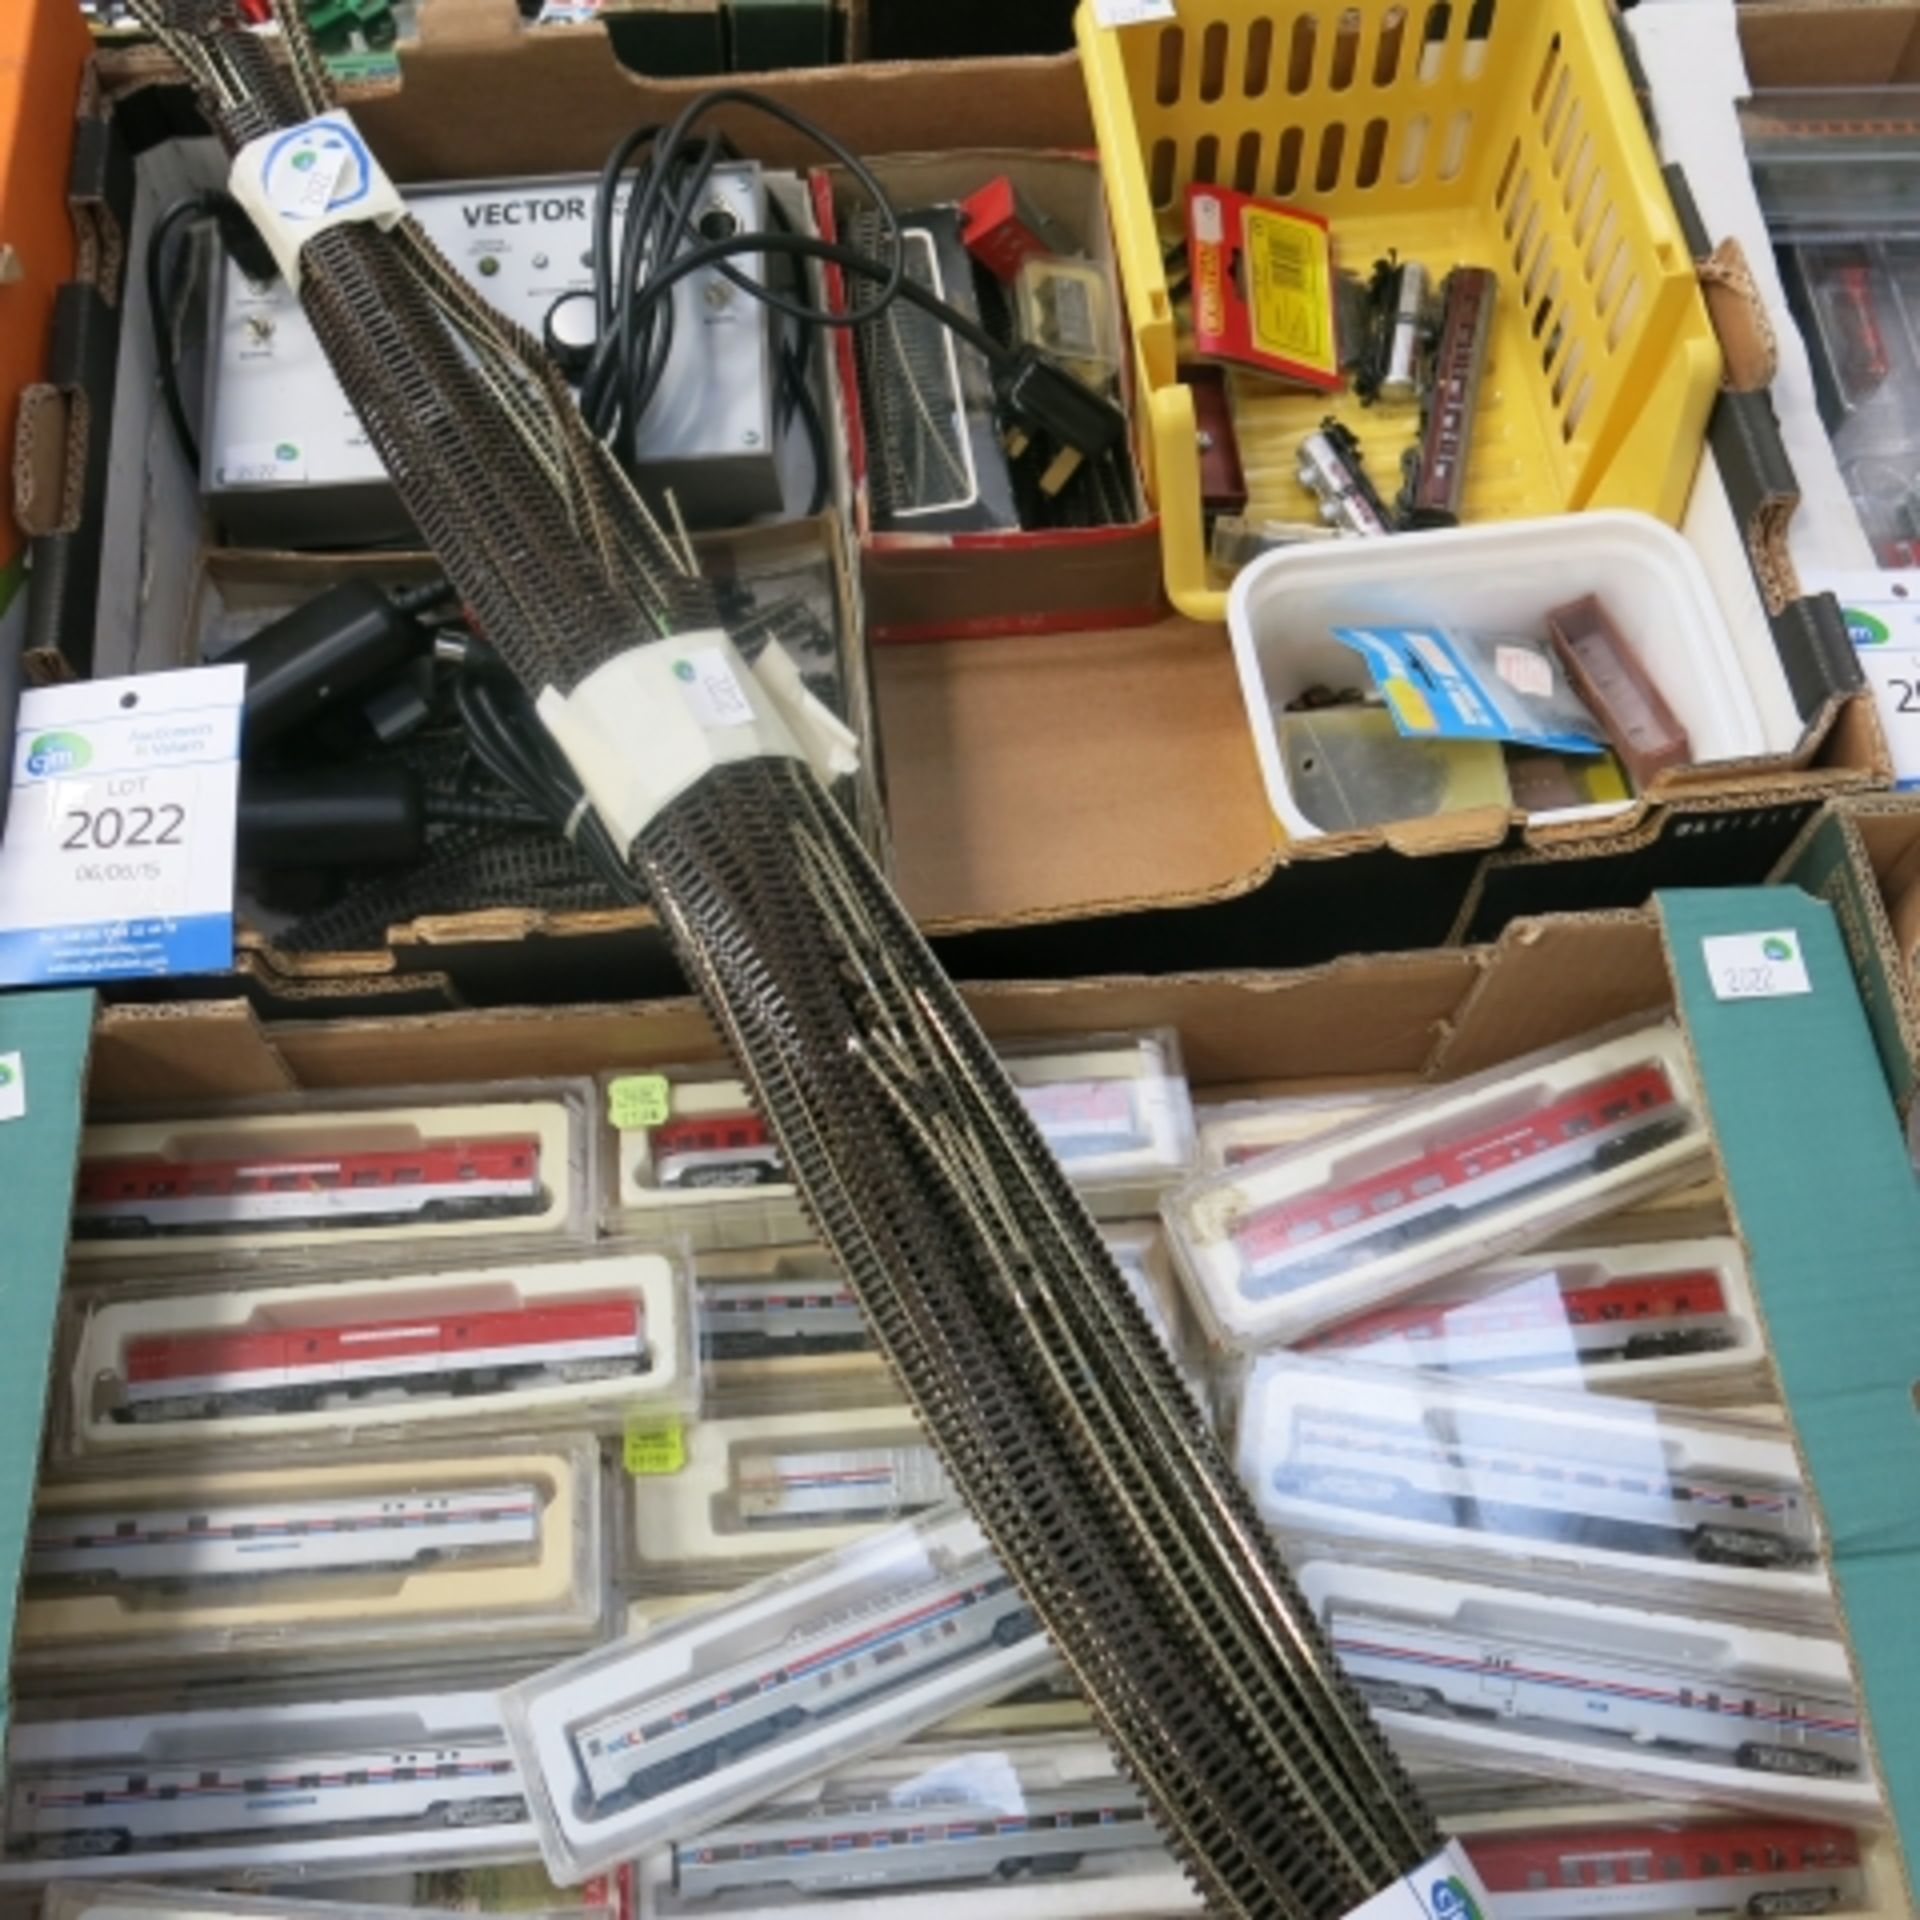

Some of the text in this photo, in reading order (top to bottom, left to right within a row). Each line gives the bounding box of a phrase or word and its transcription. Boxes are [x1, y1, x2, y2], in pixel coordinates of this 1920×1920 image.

[462, 197, 586, 228] VECTOR
[107, 776, 149, 798] LOT
[61, 803, 186, 852] 2022
